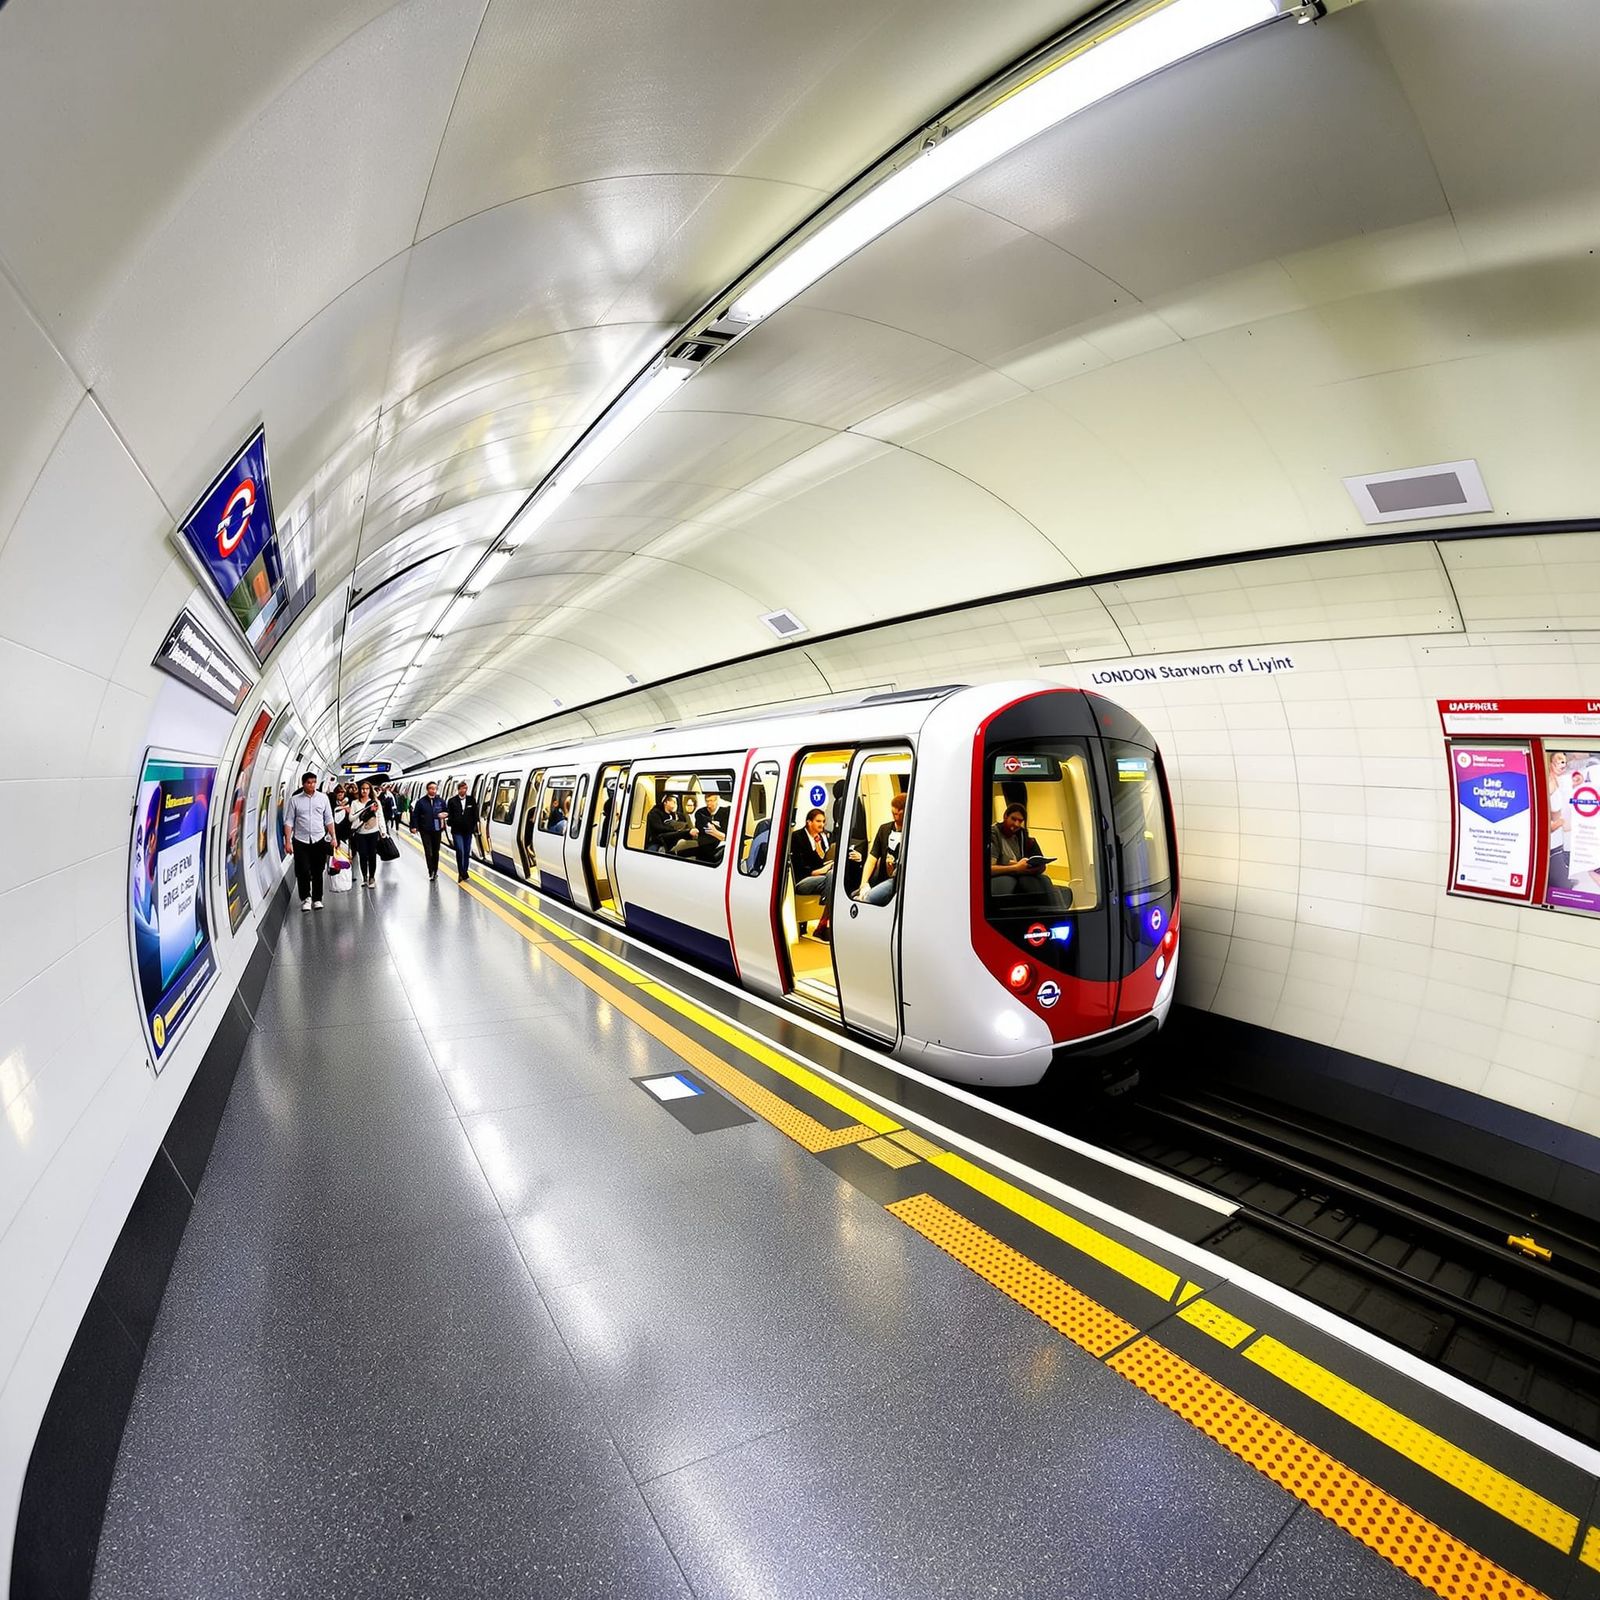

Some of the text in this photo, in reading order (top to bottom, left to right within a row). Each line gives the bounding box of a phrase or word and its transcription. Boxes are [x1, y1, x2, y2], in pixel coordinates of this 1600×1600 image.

[1092, 667, 1157, 684] LONDON
[1159, 663, 1225, 679] Starworn
[1229, 659, 1245, 673] of
